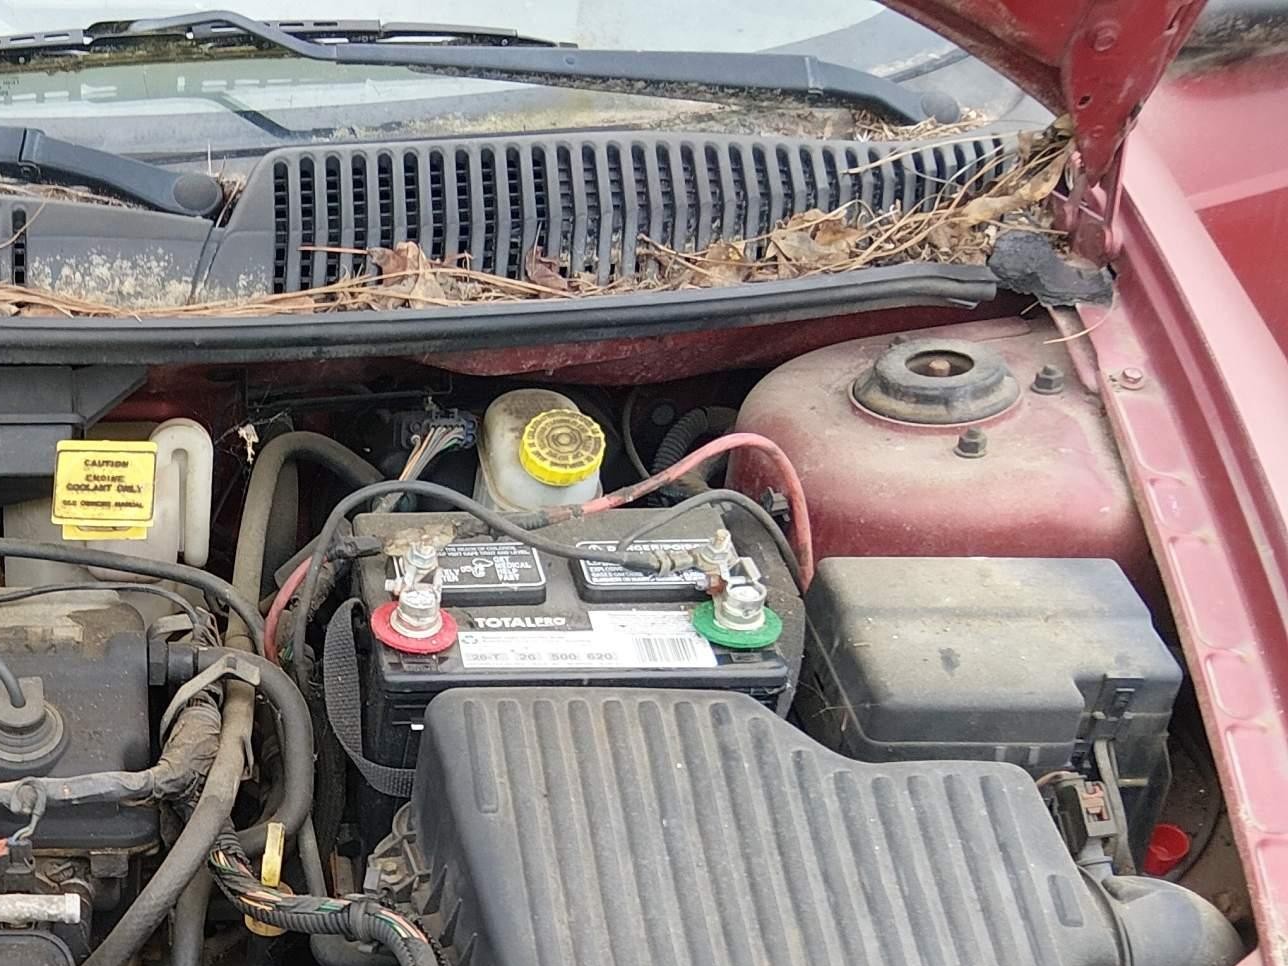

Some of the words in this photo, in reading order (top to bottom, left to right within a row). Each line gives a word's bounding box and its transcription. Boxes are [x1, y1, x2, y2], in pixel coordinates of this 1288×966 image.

[84, 459, 129, 468] CAUTION
[66, 483, 112, 491] COOLANT
[117, 484, 143, 493] ONLY
[474, 616, 567, 629] TOTALPRO
[586, 652, 614, 660] 620
